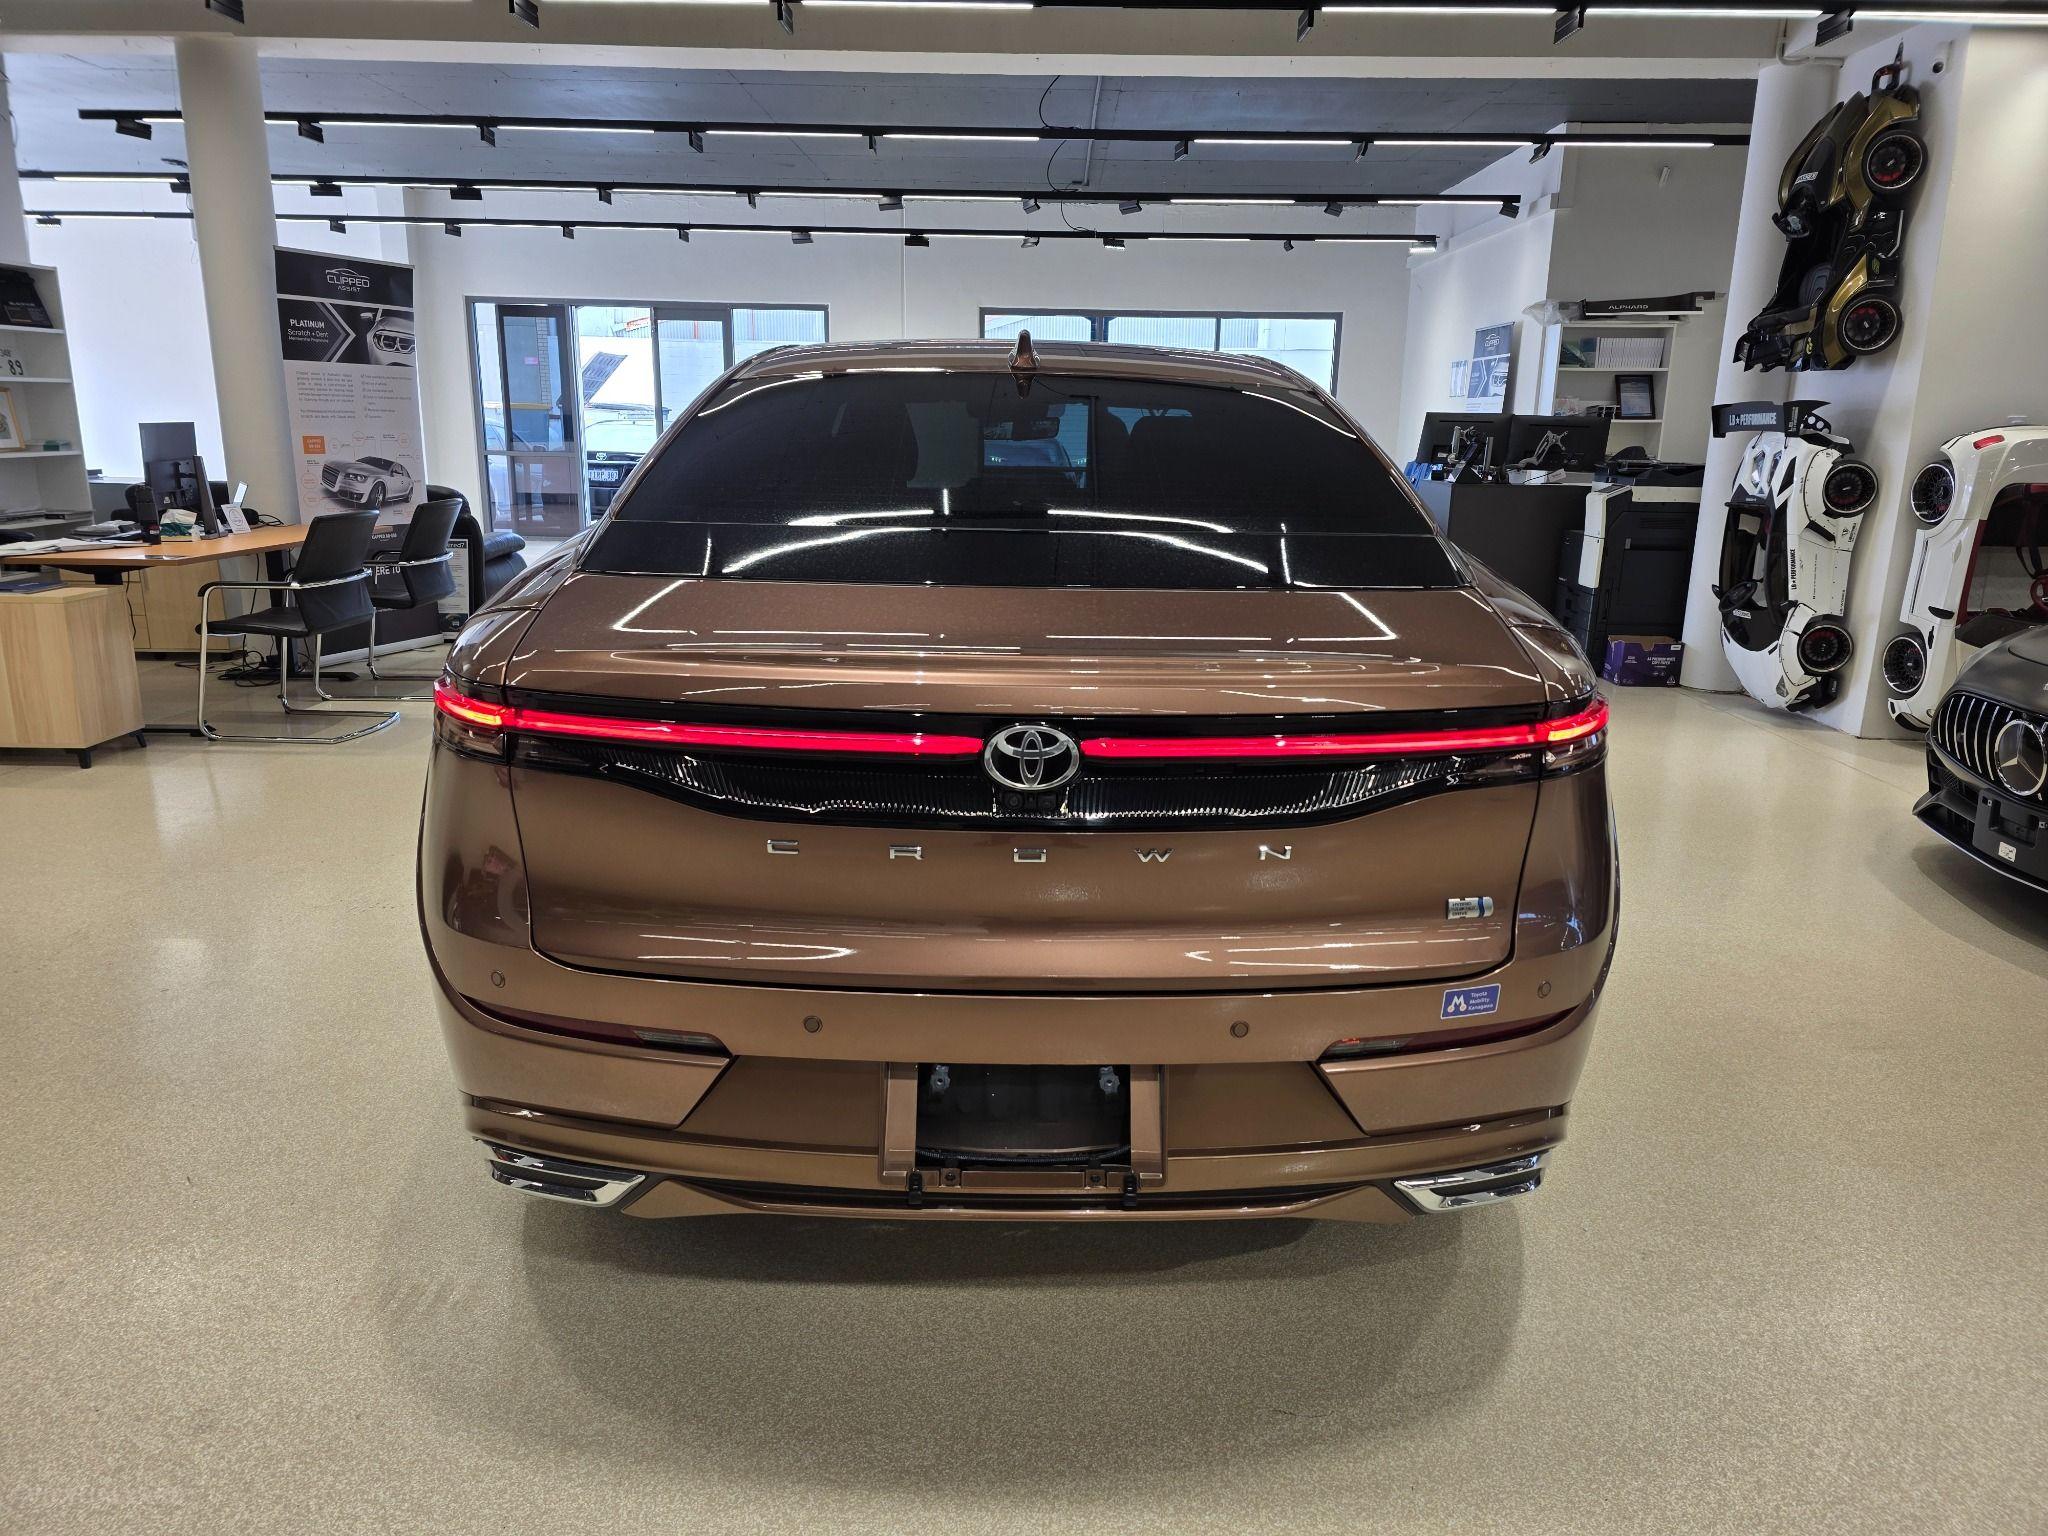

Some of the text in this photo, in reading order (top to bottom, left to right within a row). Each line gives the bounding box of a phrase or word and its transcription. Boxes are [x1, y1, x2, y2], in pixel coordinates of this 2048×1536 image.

[326, 274, 370, 288] CLIPPED
[289, 318, 325, 329] PLATINUM
[287, 328, 310, 337] Scratch
[1739, 412, 1777, 426] PERFORMANCE
[766, 839, 1292, 864] CROWN
[1471, 991, 1488, 999] Toyota
[1468, 1003, 1494, 1011] Kanagawa
